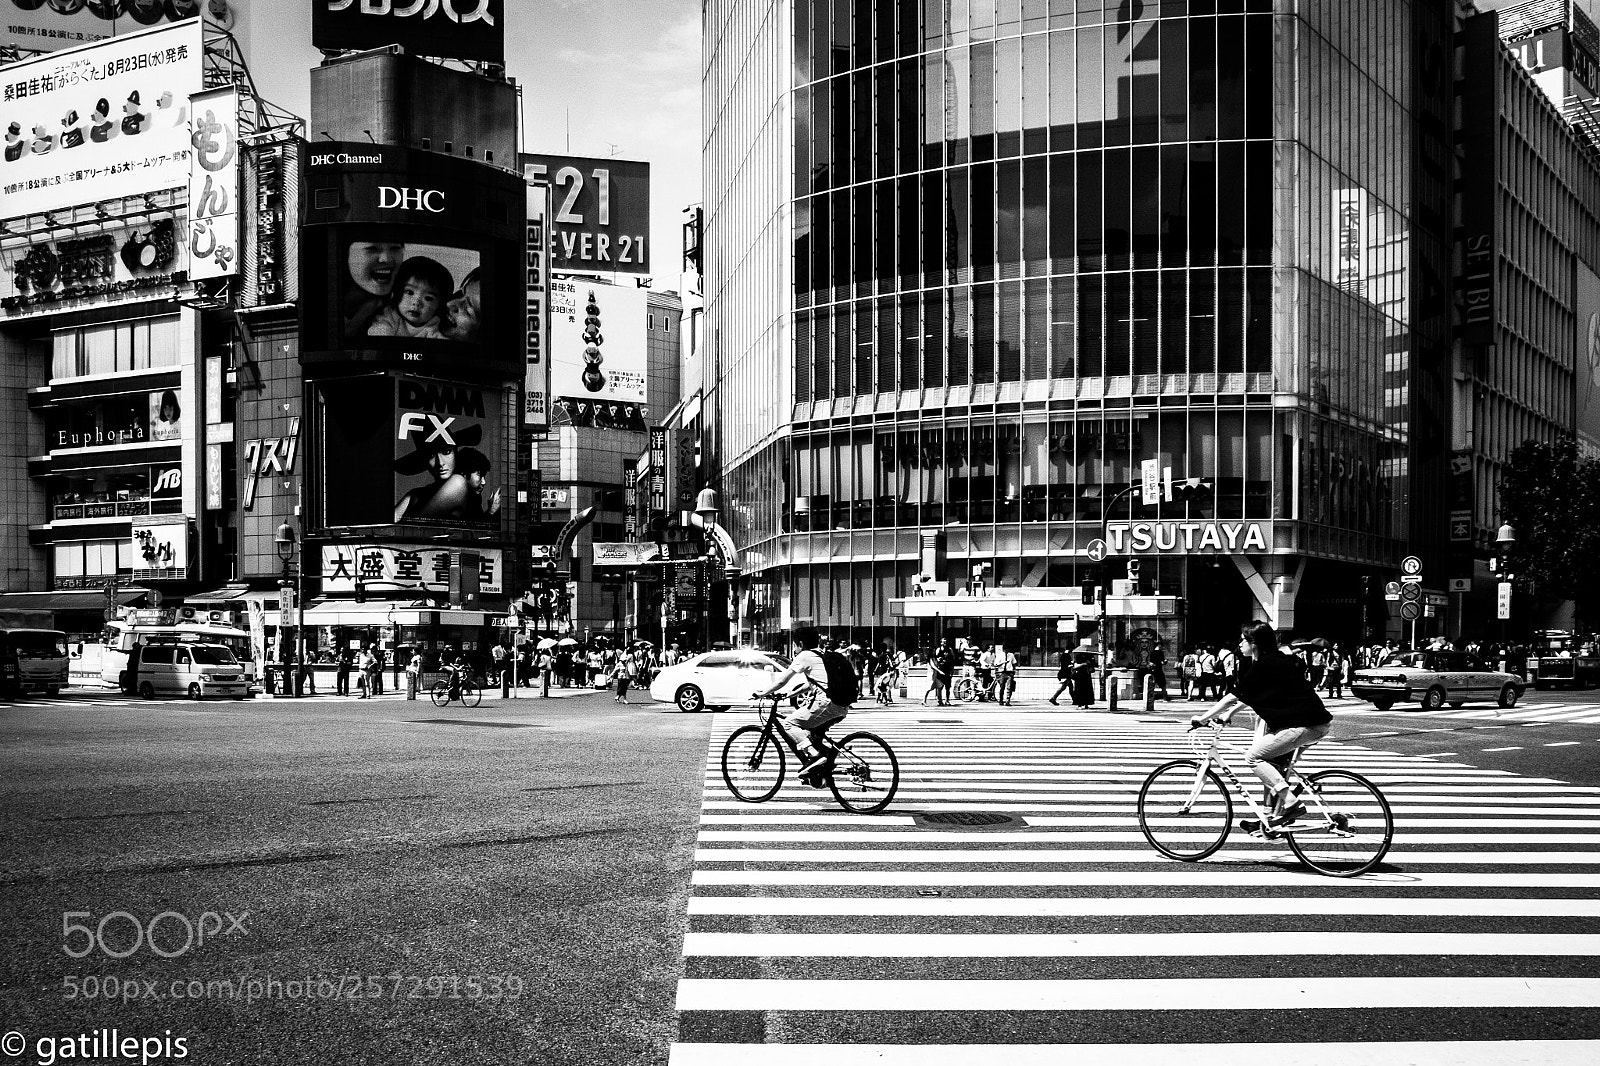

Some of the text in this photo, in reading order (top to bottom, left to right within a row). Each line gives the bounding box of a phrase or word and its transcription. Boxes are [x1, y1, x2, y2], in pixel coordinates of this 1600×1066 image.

[311, 152, 382, 166] DHC Channel
[191, 108, 235, 271] もんじゃ
[378, 186, 445, 213] DHC
[524, 164, 609, 226] 21
[619, 235, 644, 263] 21
[527, 213, 545, 365] Taisei neon
[1466, 234, 1491, 324] SEIBU
[403, 352, 423, 361] DHC
[398, 380, 486, 419] DMM
[526, 399, 544, 407] 3719
[528, 391, 543, 399] (03)
[58, 424, 144, 447] Euphoria
[398, 412, 457, 445] FX
[243, 416, 300, 509] クスリ
[651, 431, 665, 510] 洋服の青山
[153, 468, 182, 493] JTB
[87, 506, 114, 517] 海外旅行
[1108, 523, 1267, 551] TSUTAYA
[1222, 765, 1250, 800] GIANT
